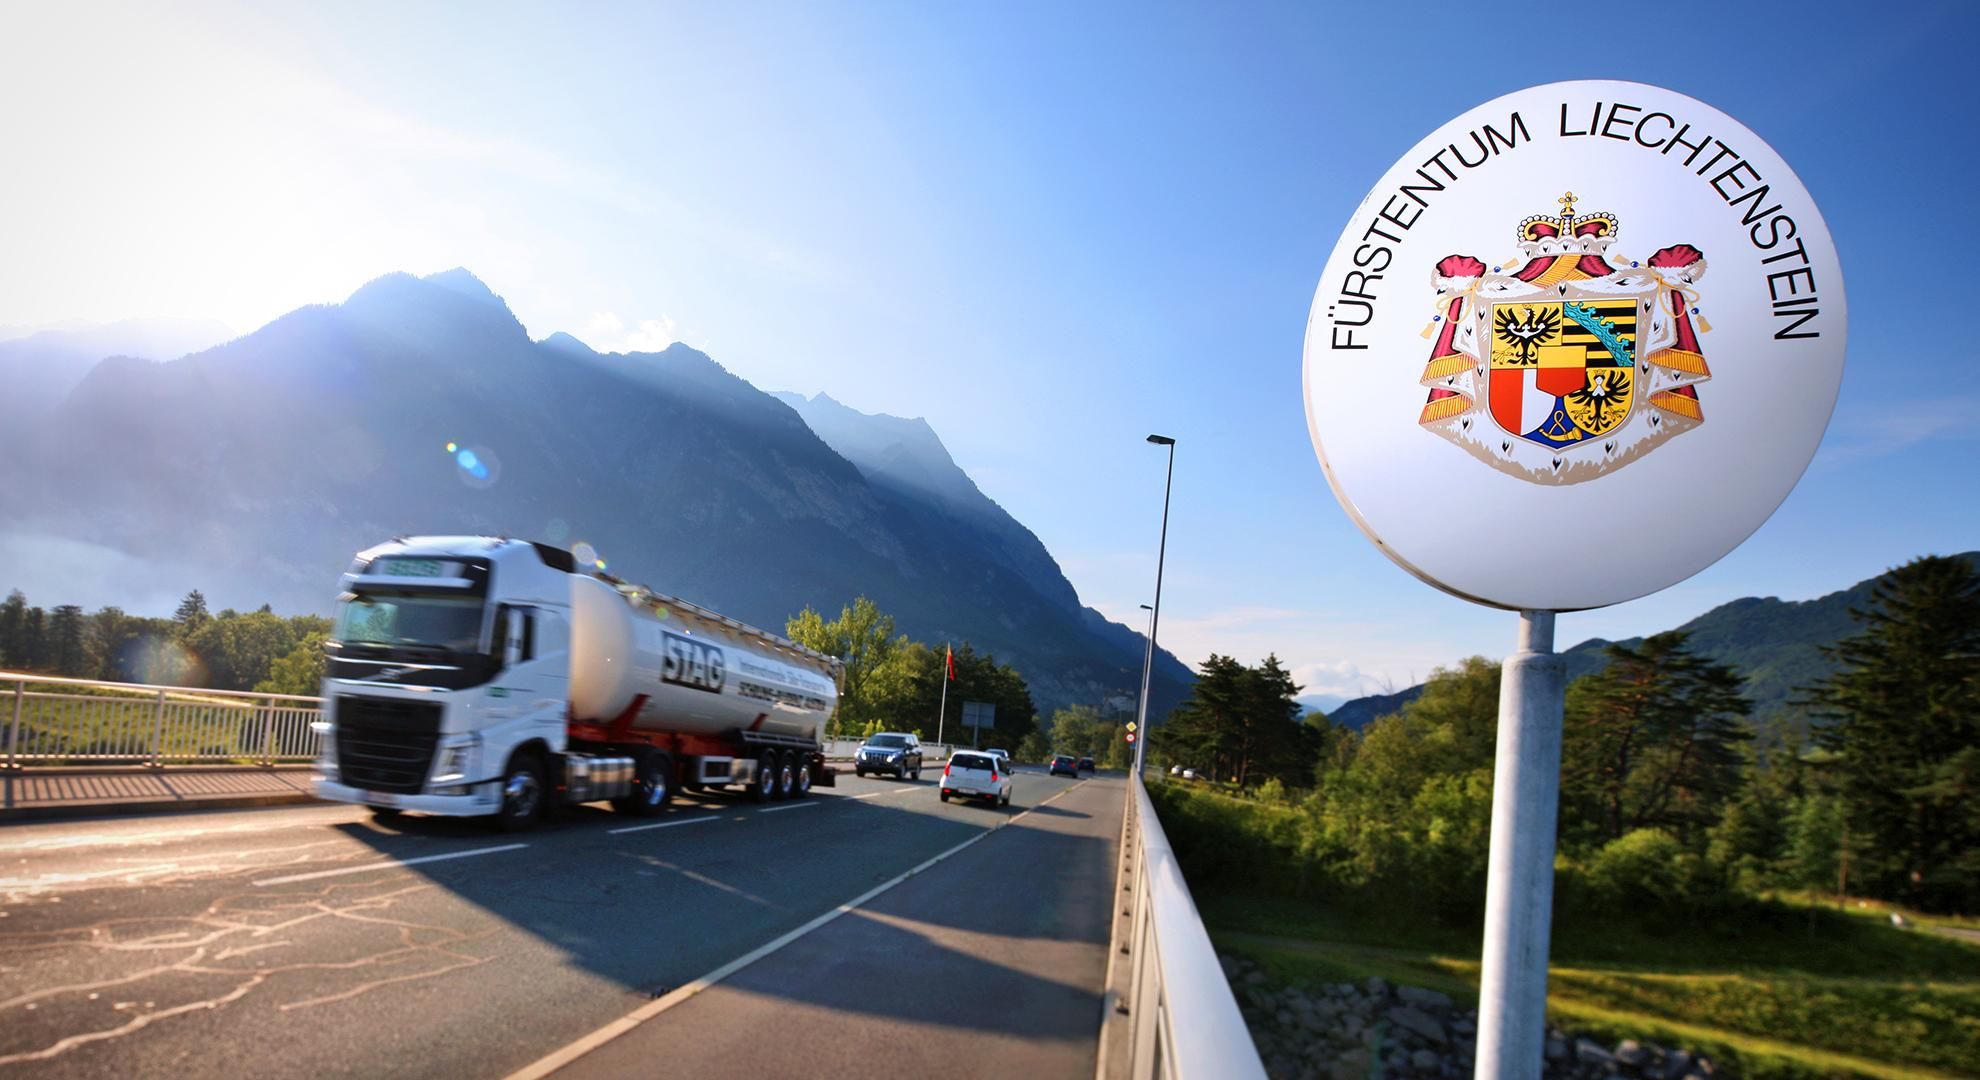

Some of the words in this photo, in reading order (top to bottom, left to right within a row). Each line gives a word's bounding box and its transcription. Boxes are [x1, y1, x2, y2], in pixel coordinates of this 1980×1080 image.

[1328, 111, 1531, 350] FÜRSTENTUM
[1560, 101, 1820, 340] LIECHTENSTEIN
[663, 635, 726, 690] STAG
